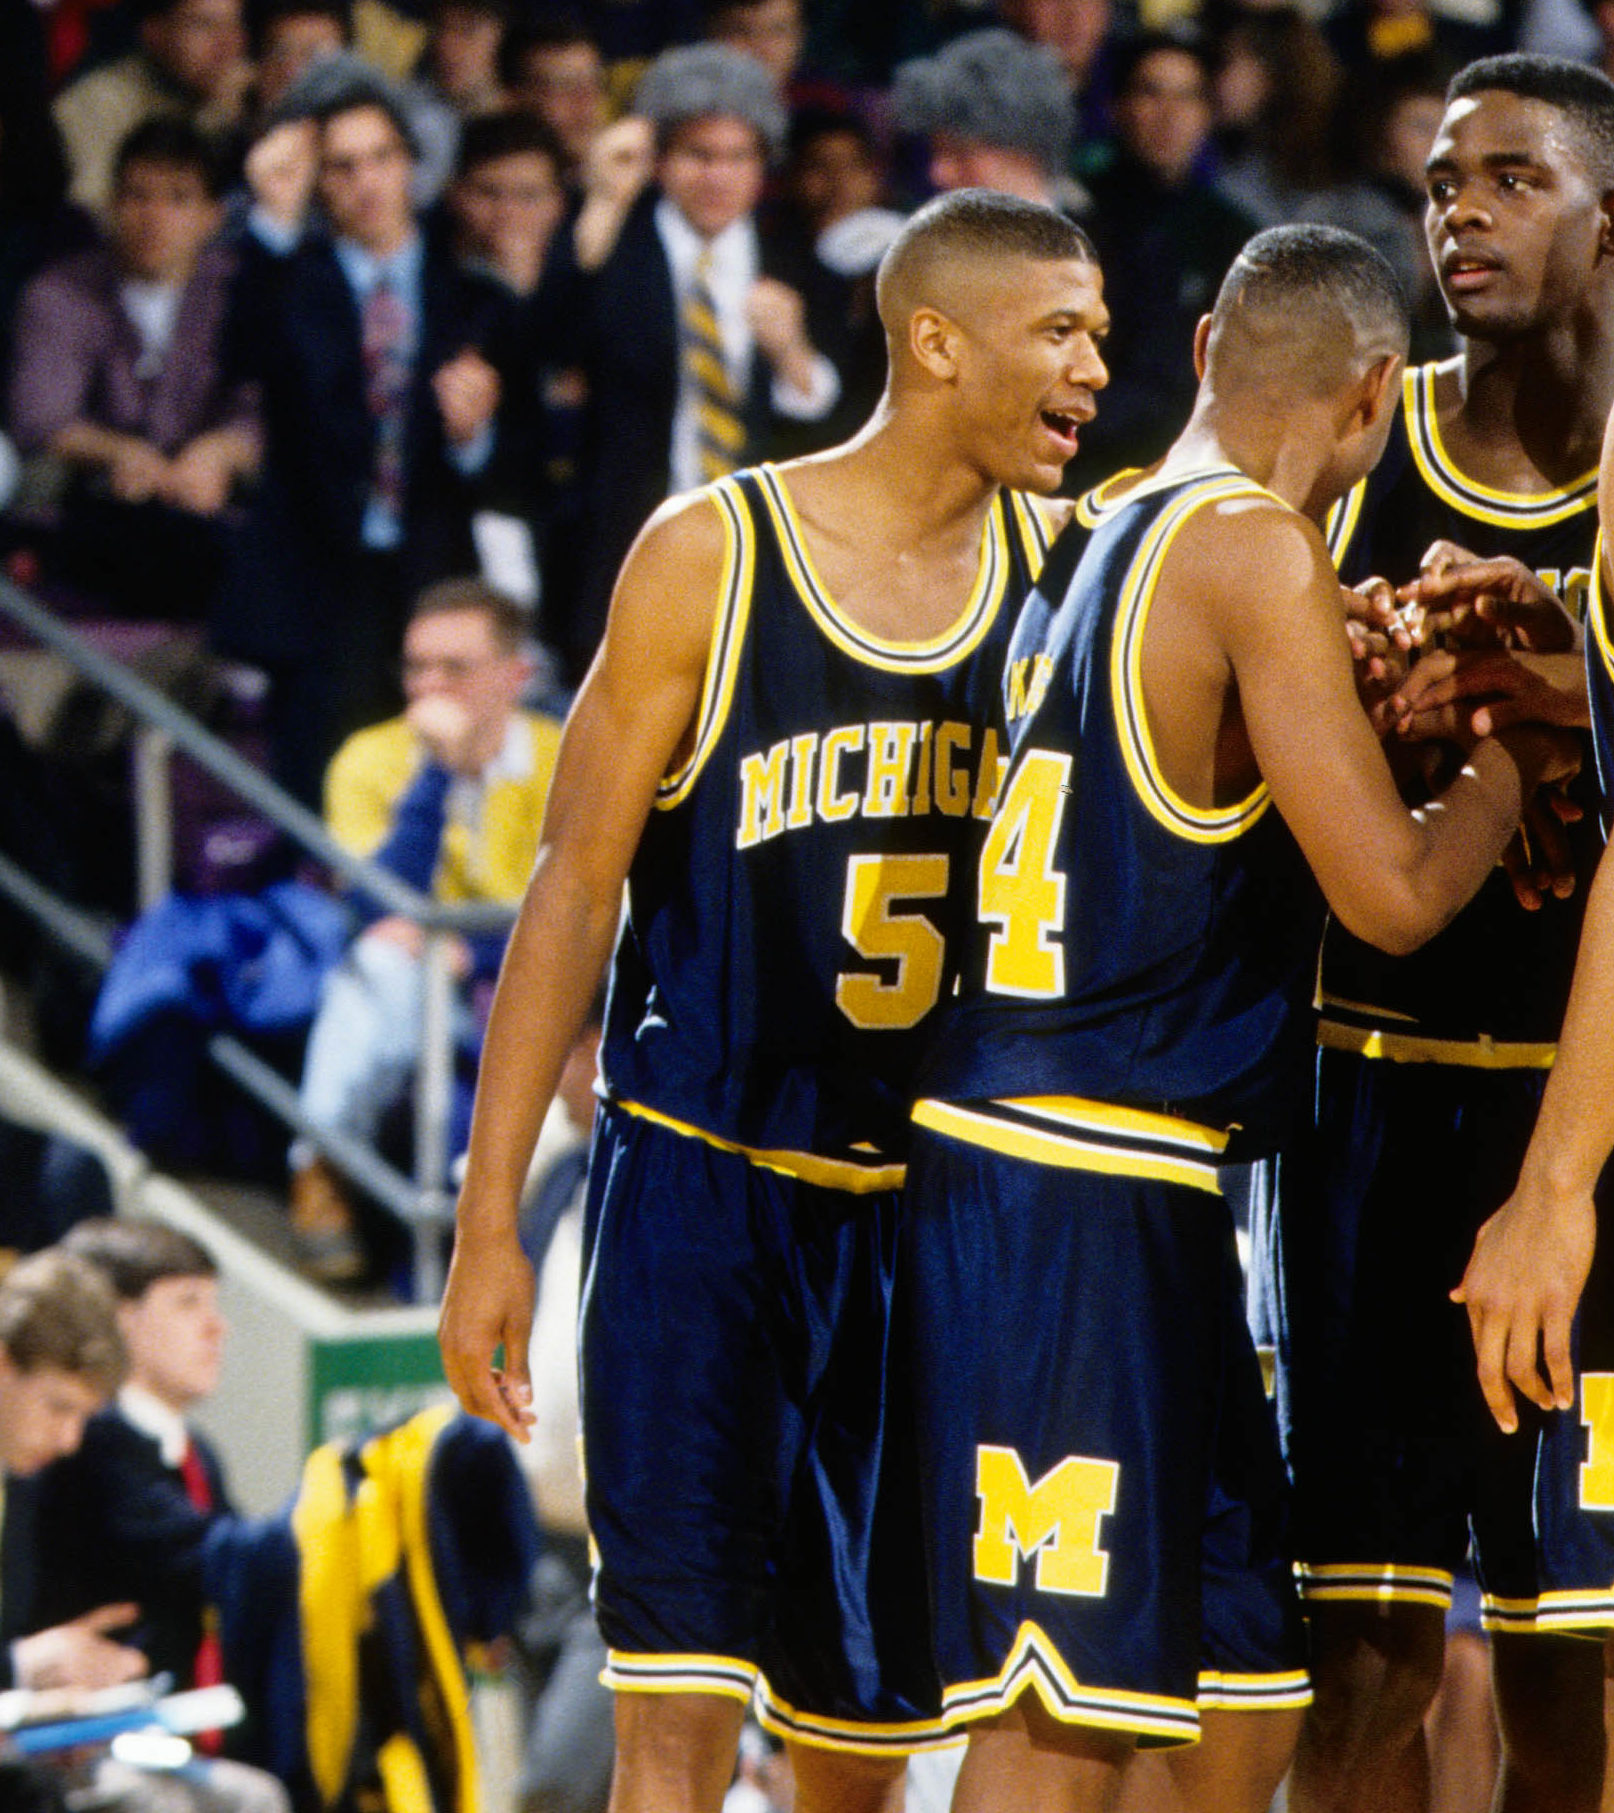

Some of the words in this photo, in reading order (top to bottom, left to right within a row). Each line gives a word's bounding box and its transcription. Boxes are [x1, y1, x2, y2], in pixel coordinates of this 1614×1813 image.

[736, 719, 1010, 850] MICHIGA
[835, 854, 949, 1029] 5
[973, 1444, 1120, 1597] M
